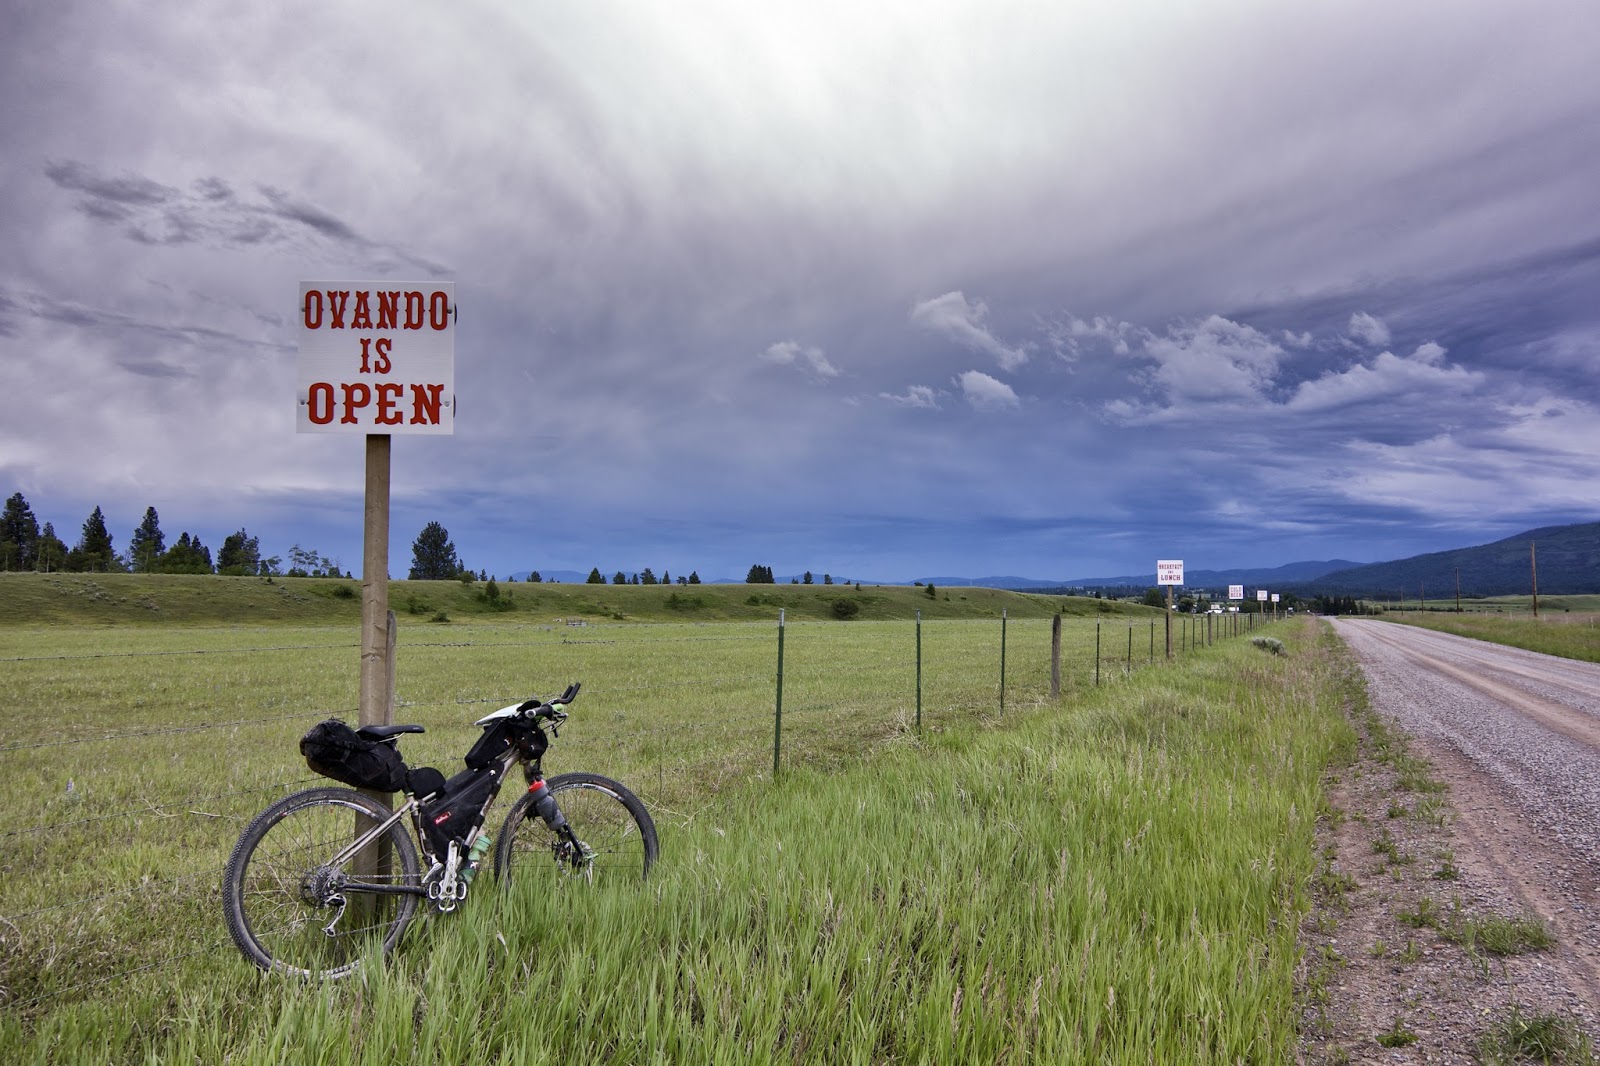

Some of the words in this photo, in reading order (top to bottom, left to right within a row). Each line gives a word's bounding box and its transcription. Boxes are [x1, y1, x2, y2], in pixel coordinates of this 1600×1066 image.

[304, 290, 449, 330] OVANDO
[360, 338, 392, 374] IS
[307, 382, 444, 425] OPEN
